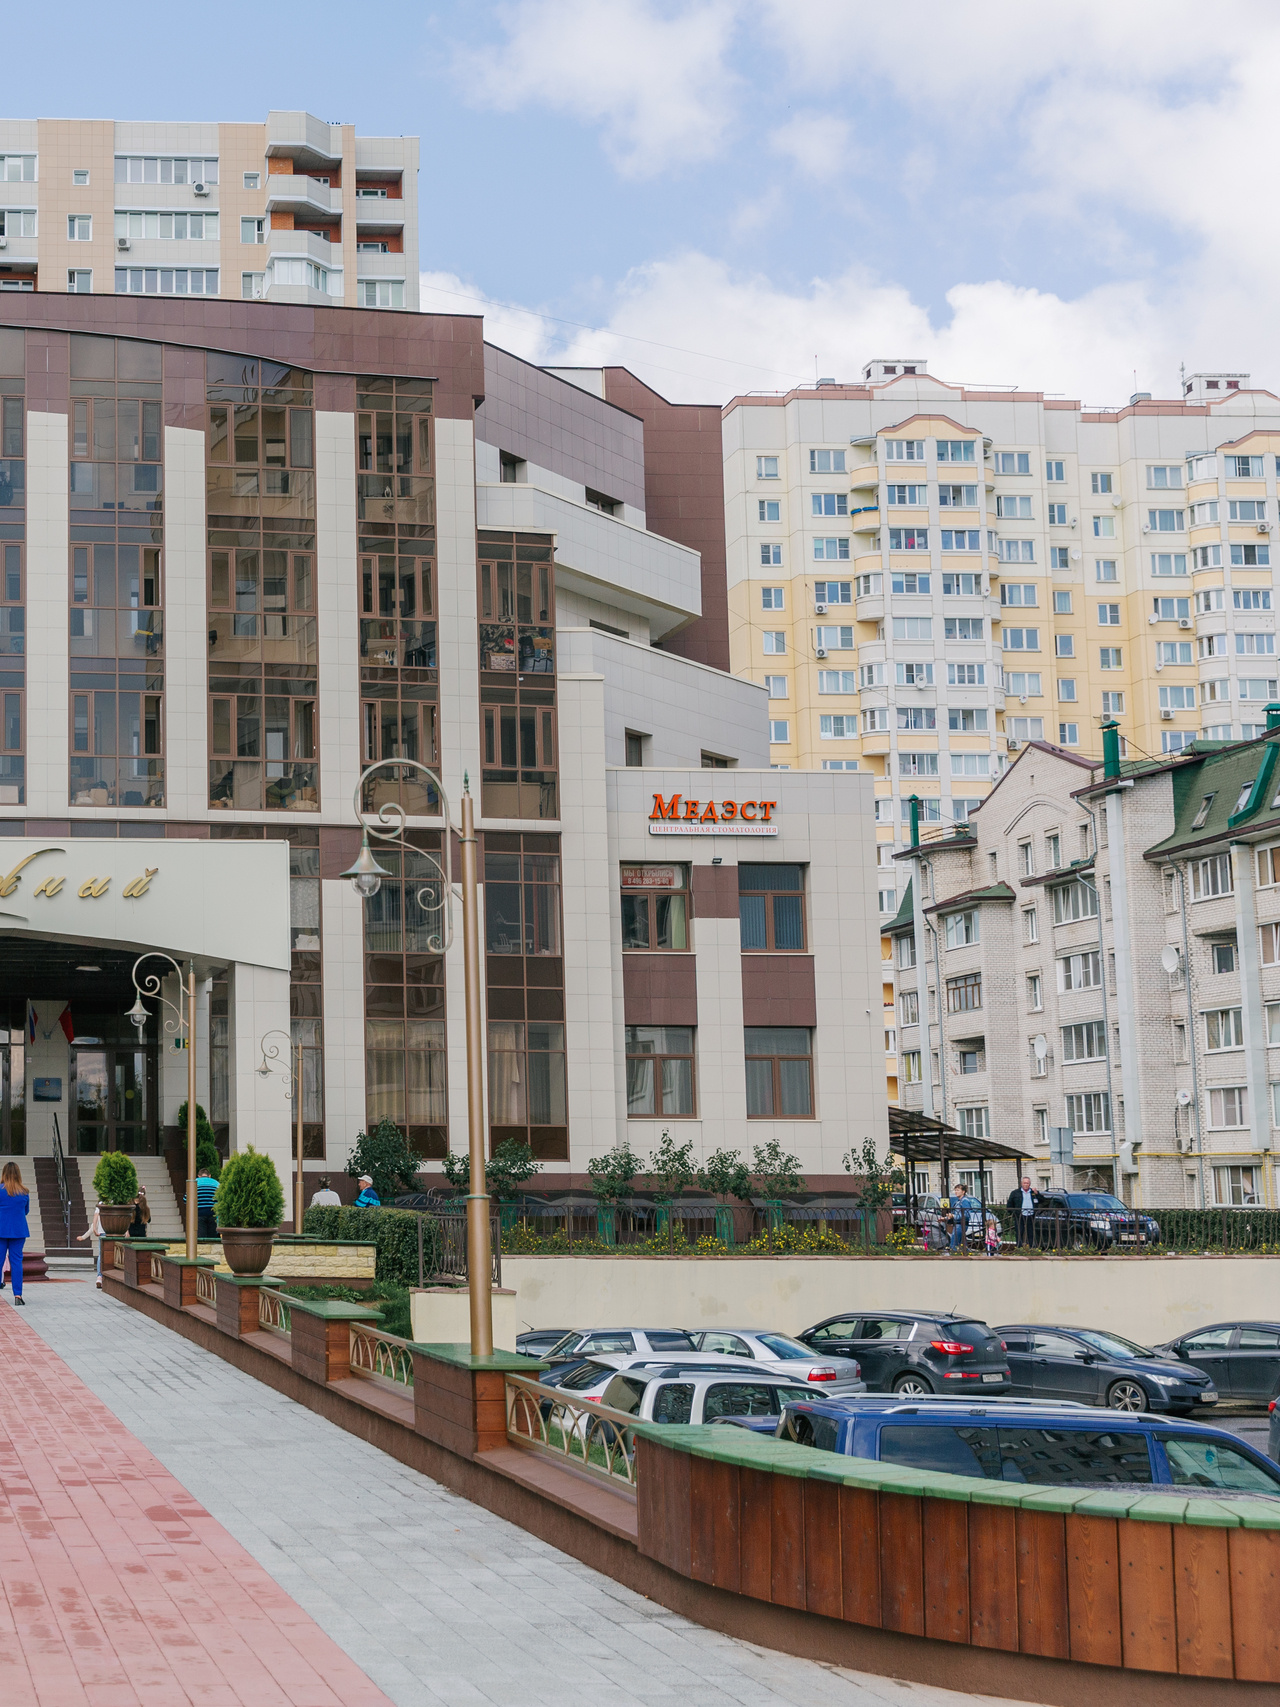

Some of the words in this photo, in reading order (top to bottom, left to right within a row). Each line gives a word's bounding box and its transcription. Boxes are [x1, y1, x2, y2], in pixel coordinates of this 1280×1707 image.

[712, 826, 777, 834] СТОМАТОЛОГИЯ
[623, 869, 635, 877] МЫ
[637, 869, 673, 877] ОТКРЫЛИСЬ
